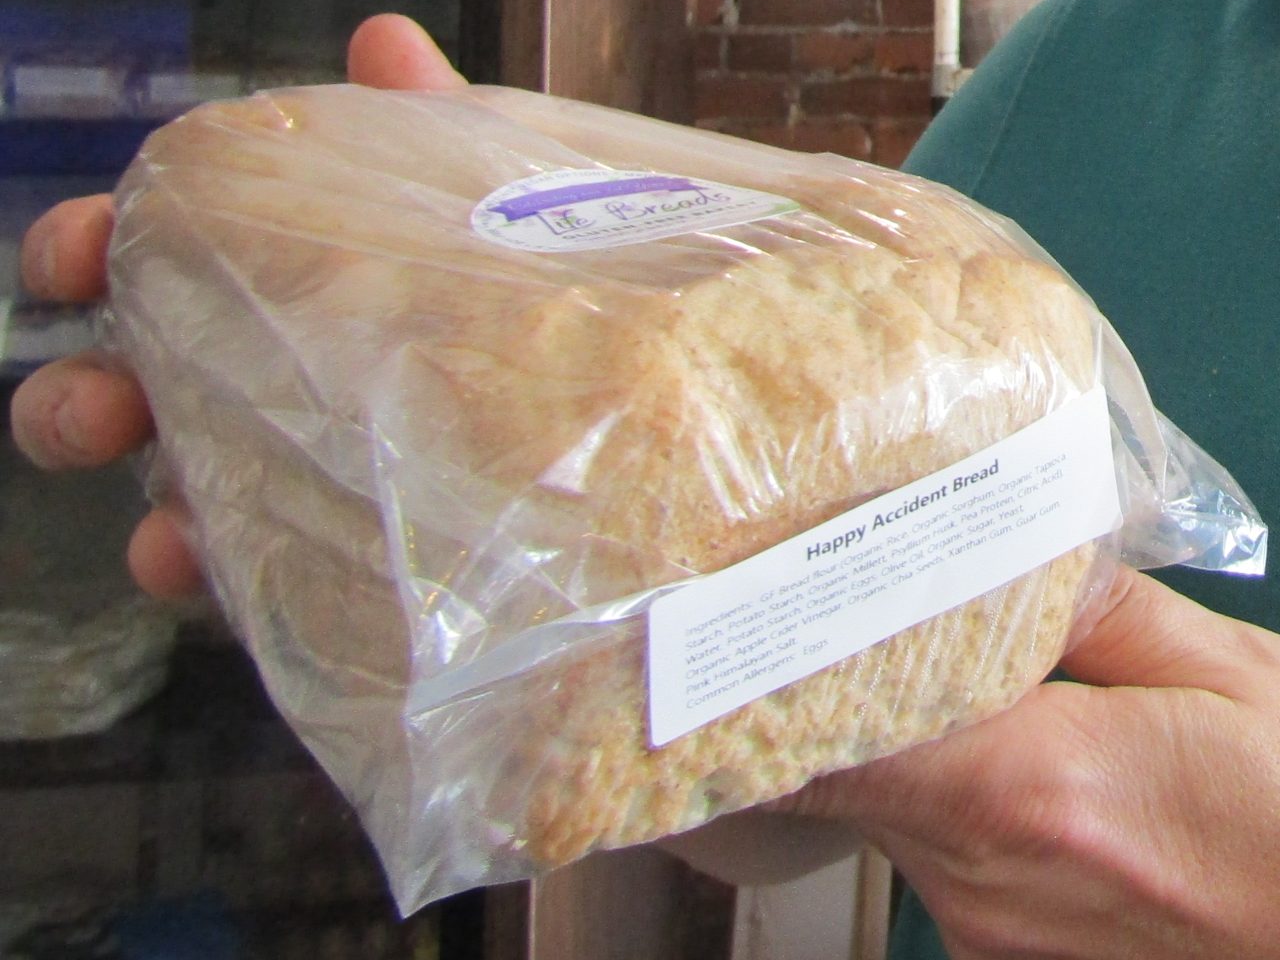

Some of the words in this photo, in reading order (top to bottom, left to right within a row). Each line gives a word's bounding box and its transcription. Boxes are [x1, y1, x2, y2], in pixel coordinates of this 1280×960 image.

[806, 525, 865, 560] Happy
[872, 485, 946, 530] Accident
[952, 459, 998, 492] Bread
[960, 511, 978, 522] Pea
[735, 637, 767, 655] Apple
[686, 679, 739, 708] Common
